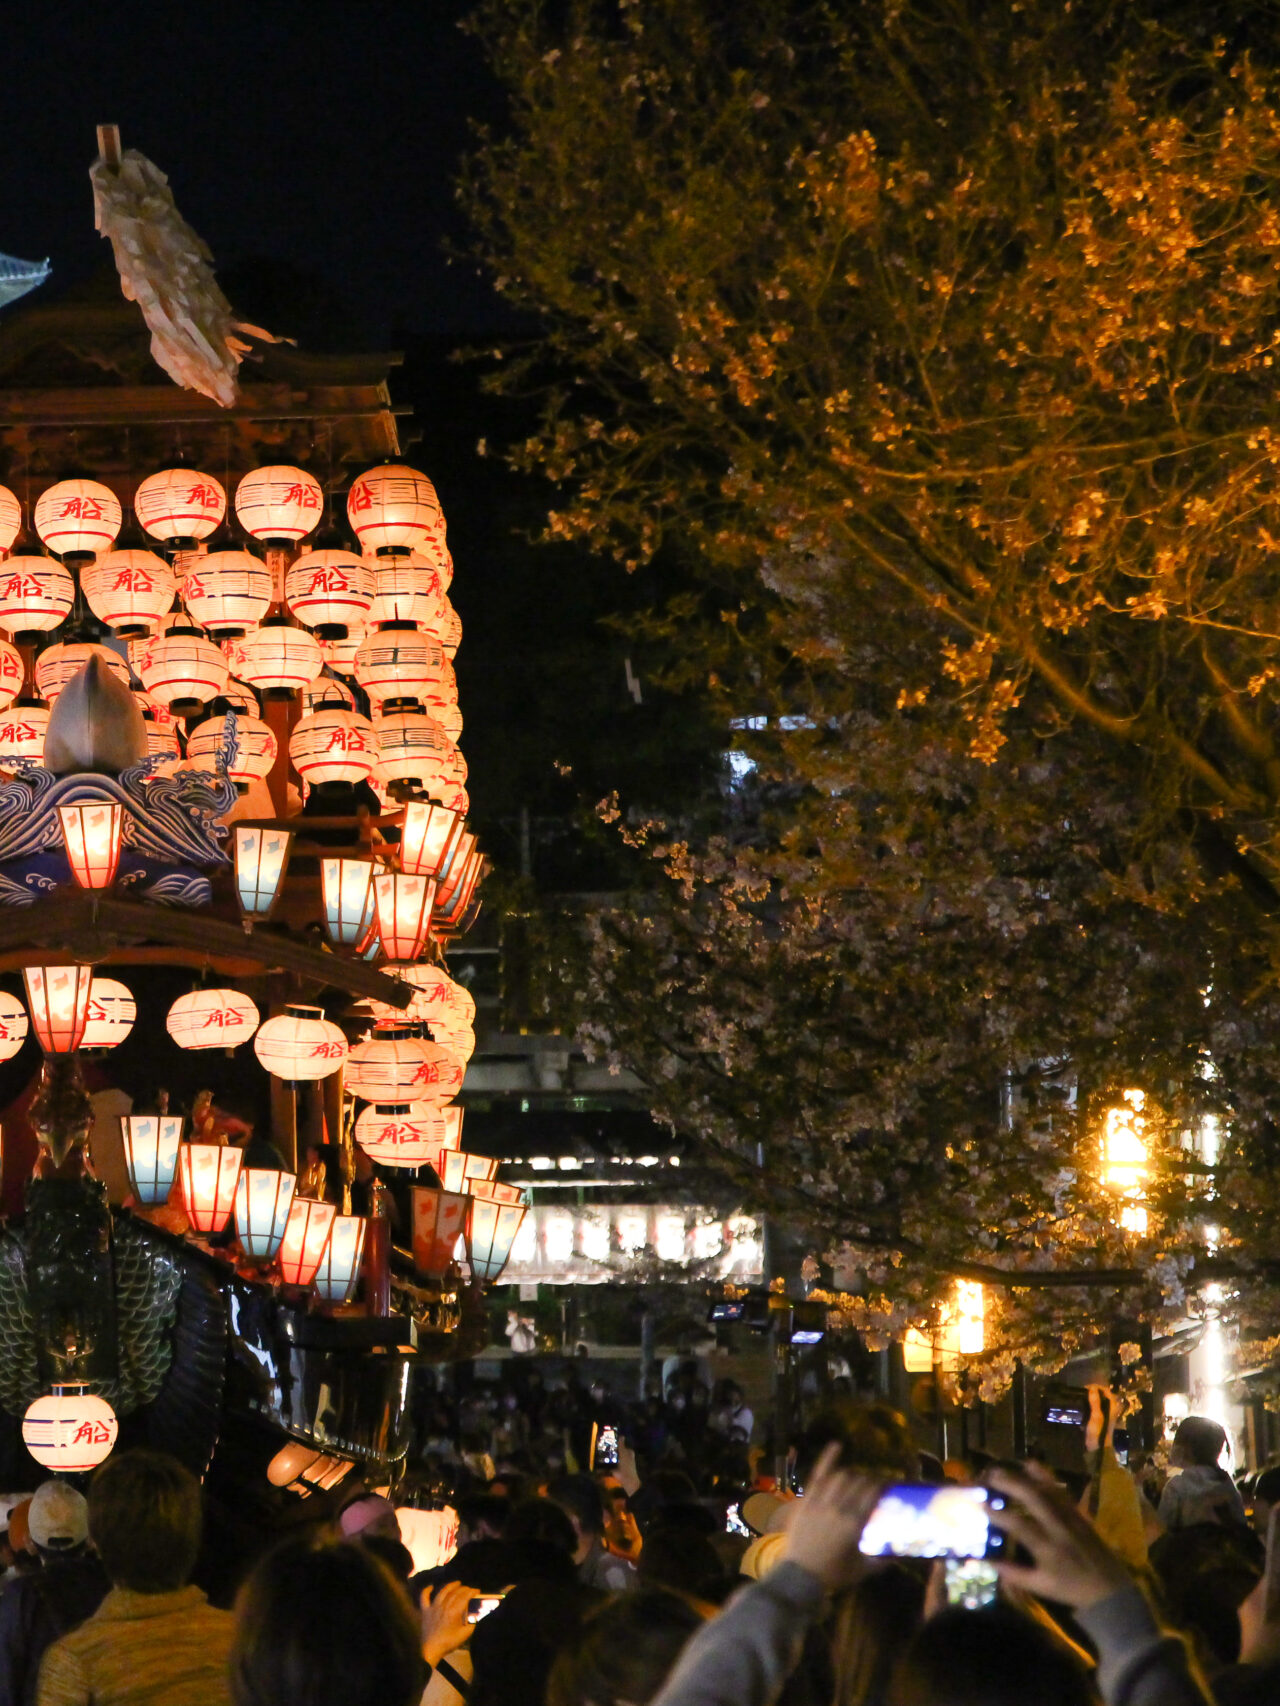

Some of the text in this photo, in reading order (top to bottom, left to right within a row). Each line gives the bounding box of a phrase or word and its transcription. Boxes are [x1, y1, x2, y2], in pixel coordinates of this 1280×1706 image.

[186, 483, 223, 509] 船
[282, 483, 320, 508] 船
[59, 497, 104, 520] 船
[3, 573, 47, 598] 船
[112, 568, 155, 592] 船
[308, 566, 350, 592] 船
[326, 727, 365, 751] 船
[203, 1008, 244, 1027] 船
[308, 1041, 343, 1058] 船
[377, 1122, 422, 1144] 船
[73, 1421, 111, 1444] 船
